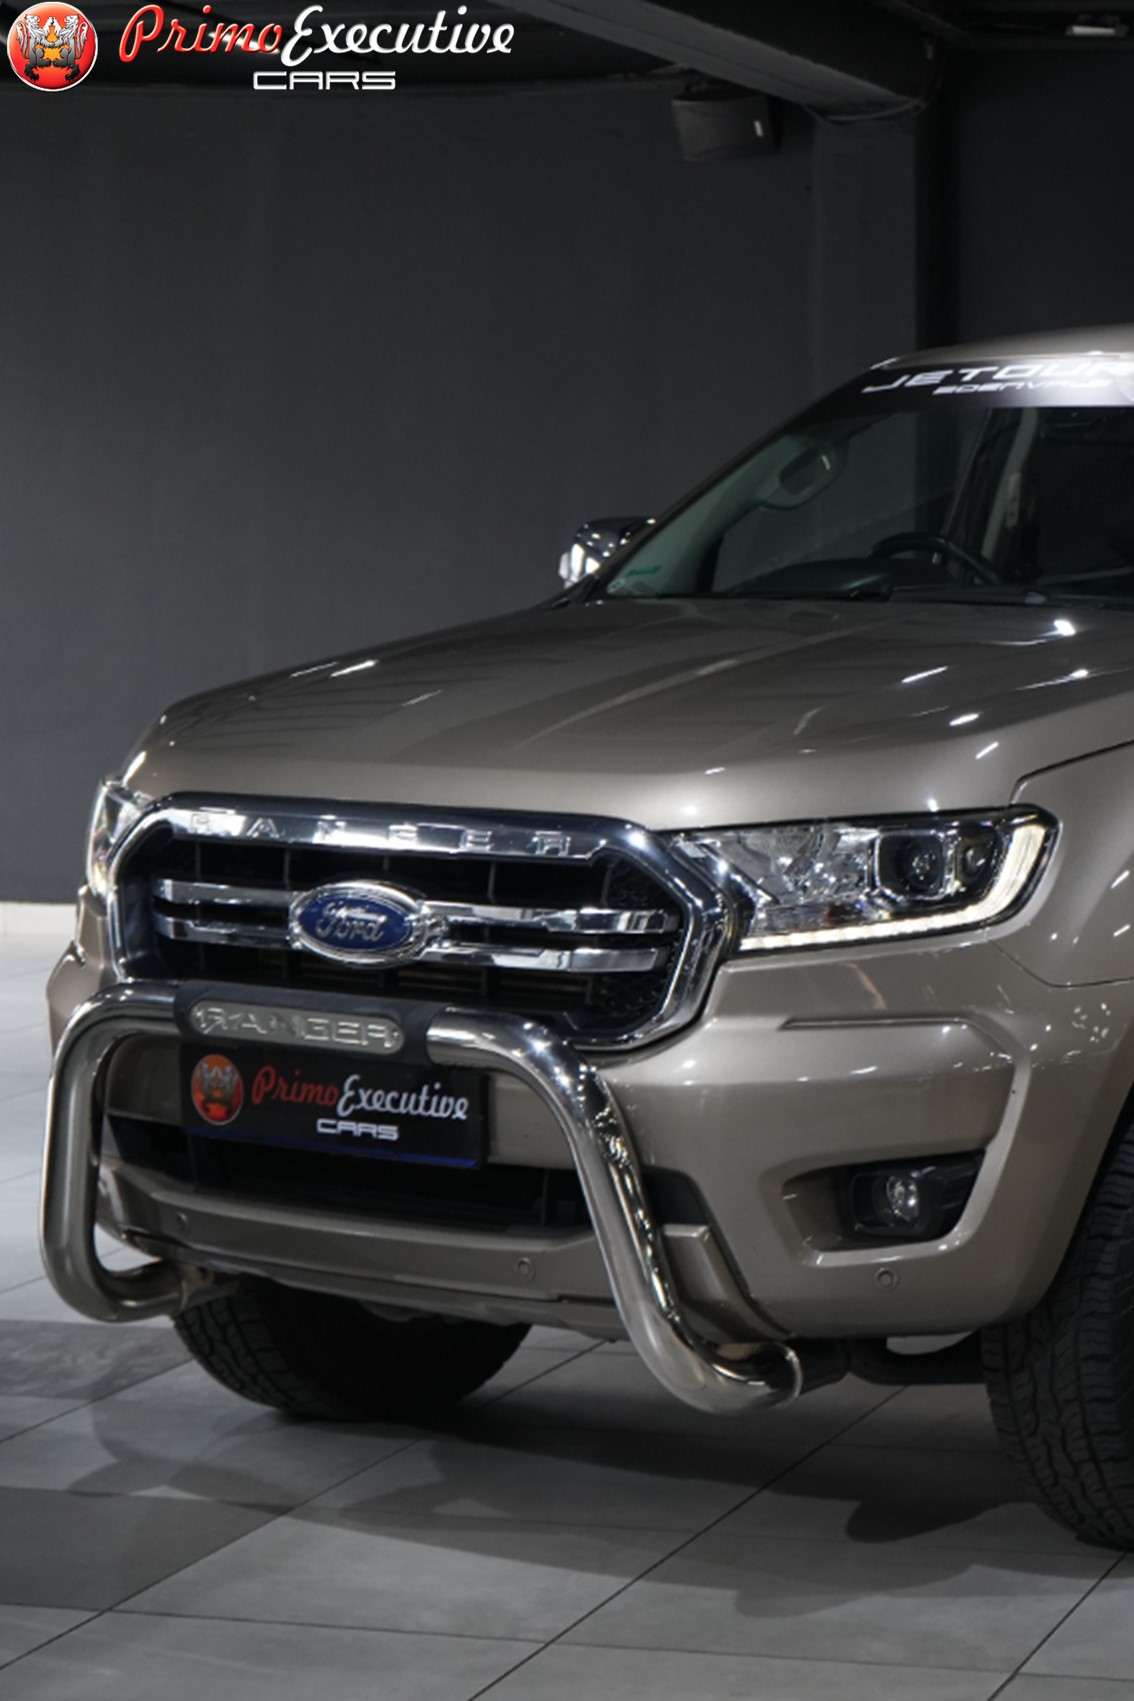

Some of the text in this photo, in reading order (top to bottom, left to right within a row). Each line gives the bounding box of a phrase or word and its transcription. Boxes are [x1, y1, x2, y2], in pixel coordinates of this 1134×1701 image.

[188, 811, 573, 857] RANGER
[316, 900, 388, 943] Ford
[193, 1006, 399, 1048] RANGER
[317, 1119, 398, 1141] CARS
